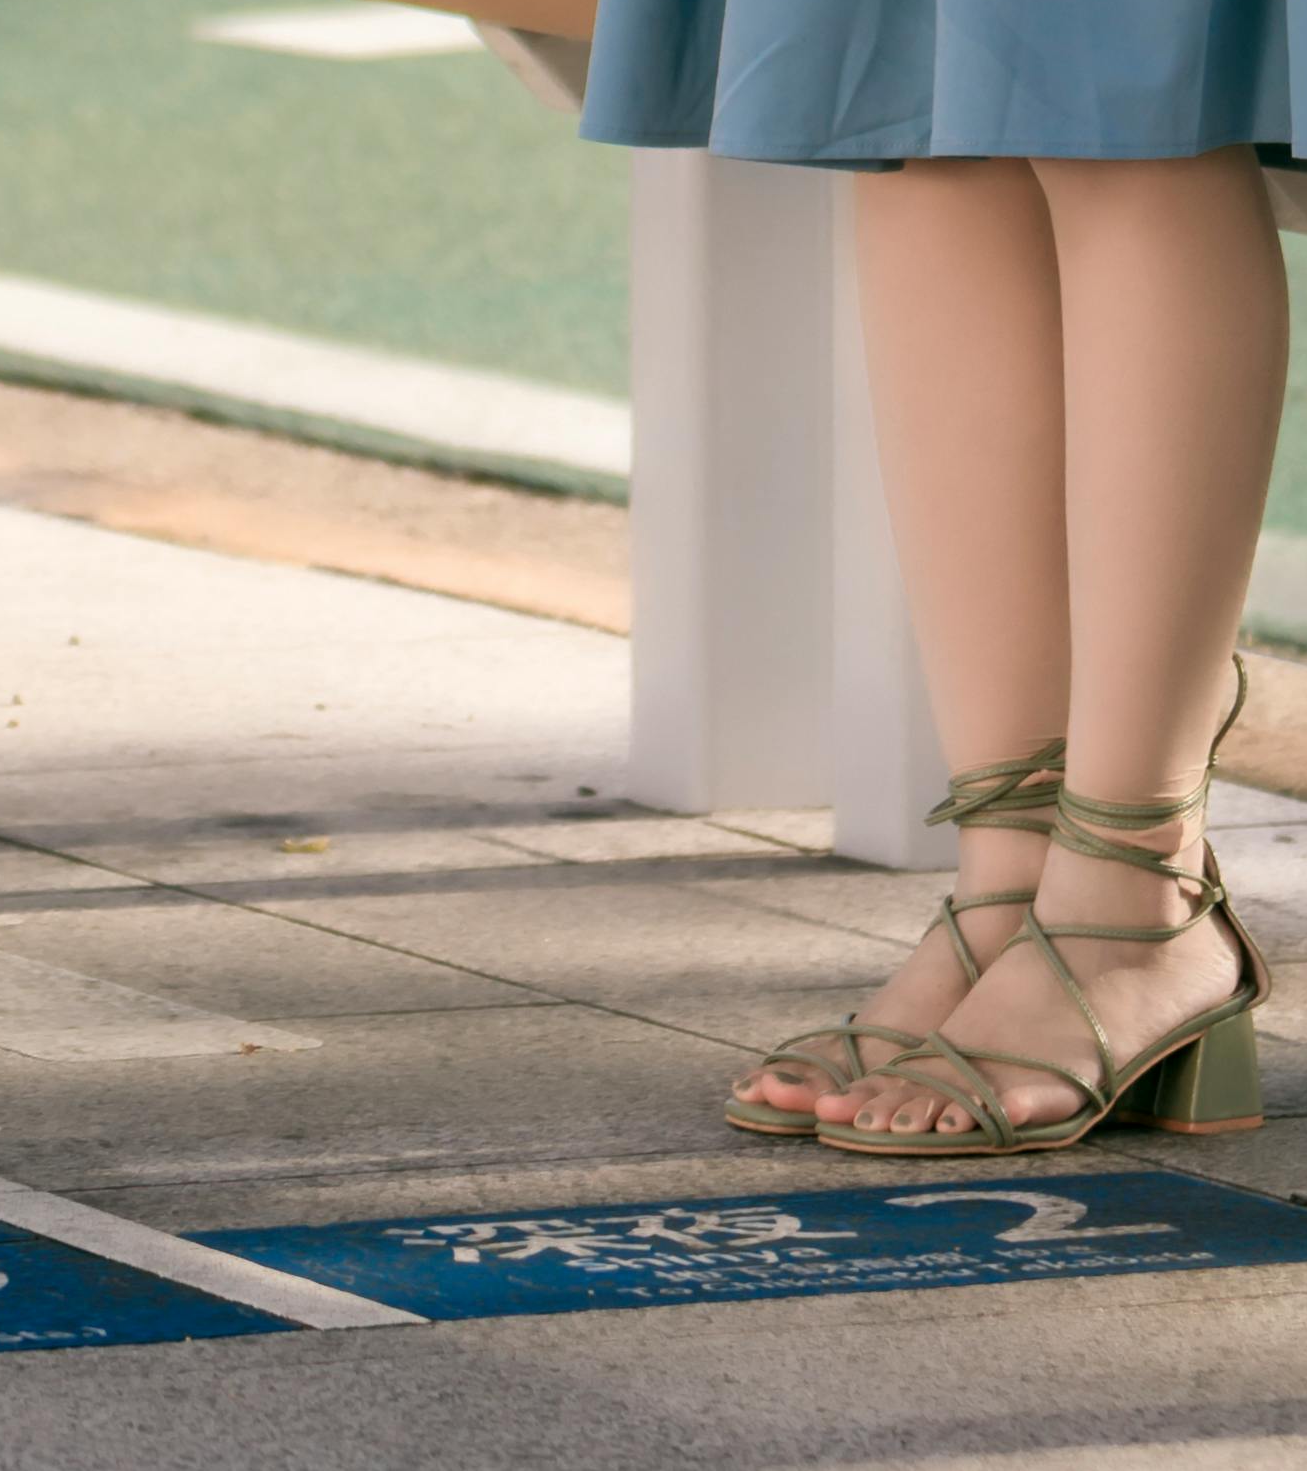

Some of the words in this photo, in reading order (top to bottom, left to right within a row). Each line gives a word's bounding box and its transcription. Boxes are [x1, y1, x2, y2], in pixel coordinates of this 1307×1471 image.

[385, 1205, 858, 1264] 深夜
[882, 1188, 1180, 1246] 2
[563, 1246, 832, 1274] Shinya
